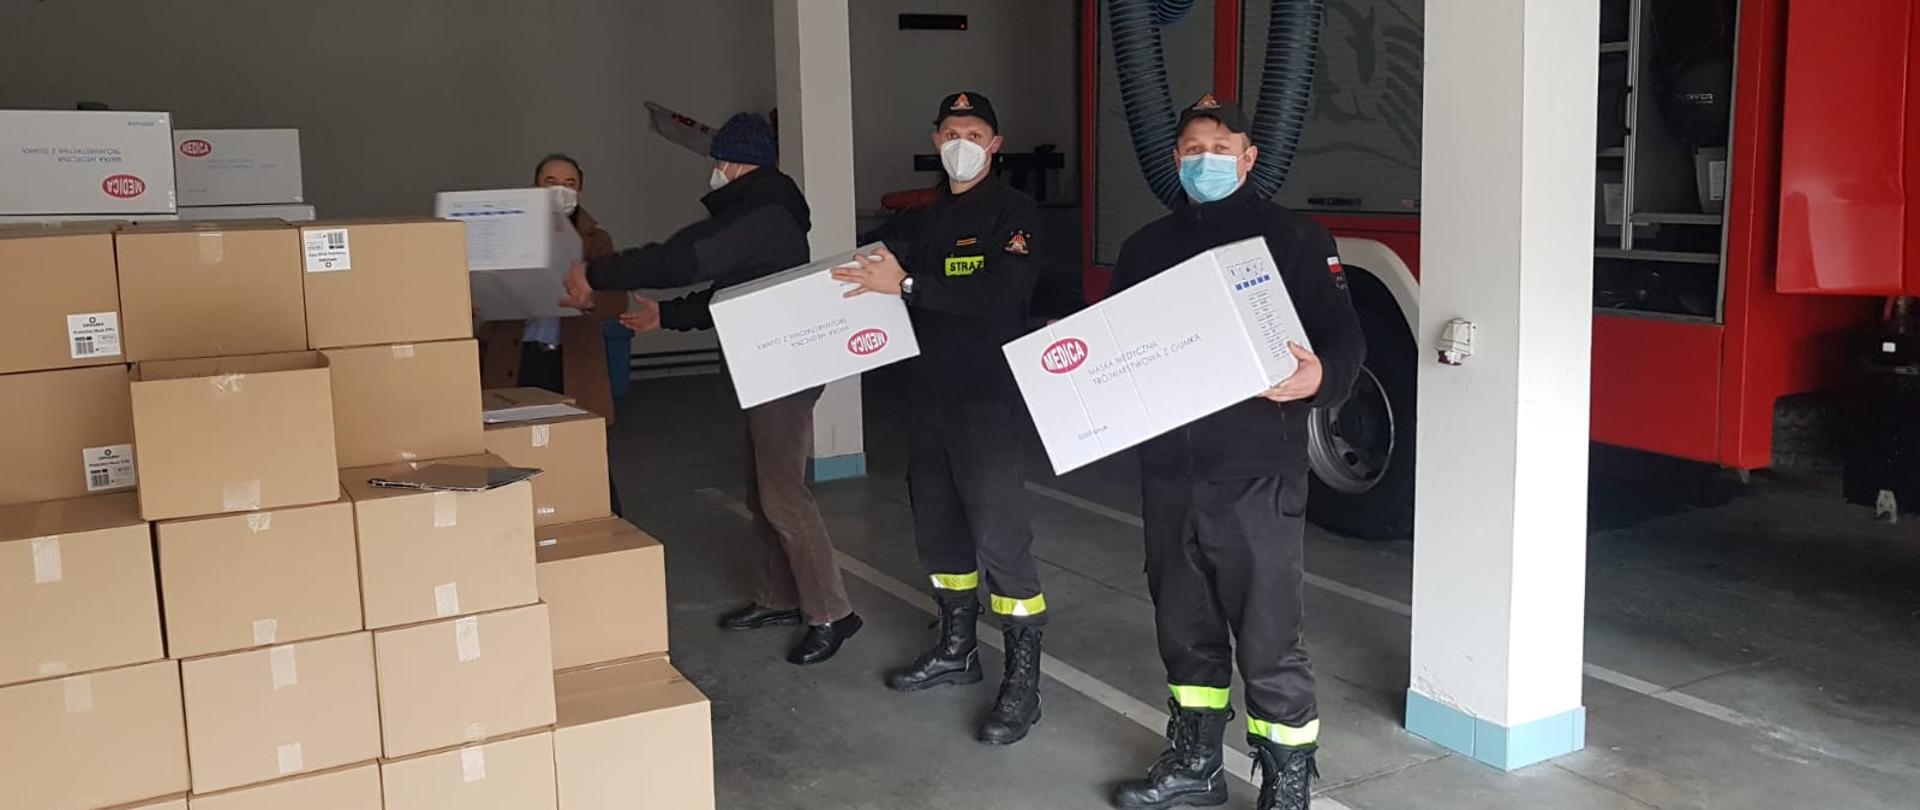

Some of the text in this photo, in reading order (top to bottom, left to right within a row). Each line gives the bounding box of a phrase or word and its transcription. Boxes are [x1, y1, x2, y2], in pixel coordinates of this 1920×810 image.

[182, 142, 209, 154] MEDICA
[106, 176, 143, 195] MEDICA
[849, 330, 887, 353] MEDICA
[1043, 342, 1085, 369] MEDICA
